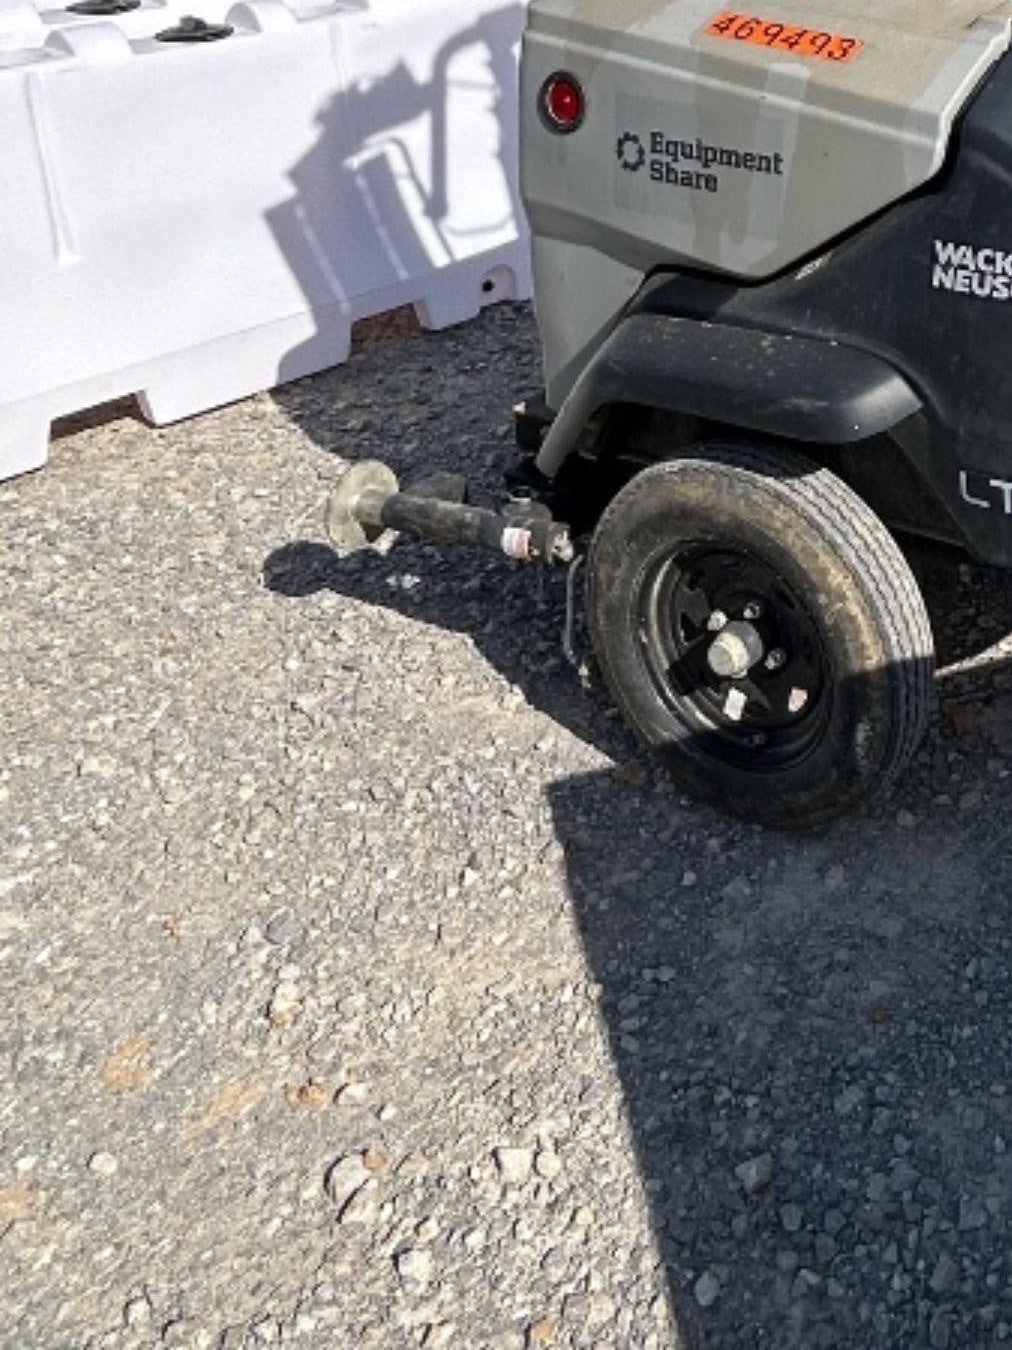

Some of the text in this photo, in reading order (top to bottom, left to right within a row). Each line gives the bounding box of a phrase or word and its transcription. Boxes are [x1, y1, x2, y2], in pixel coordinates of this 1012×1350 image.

[712, 14, 856, 61] 469493
[649, 131, 784, 175] Equipment
[650, 159, 718, 193] Share
